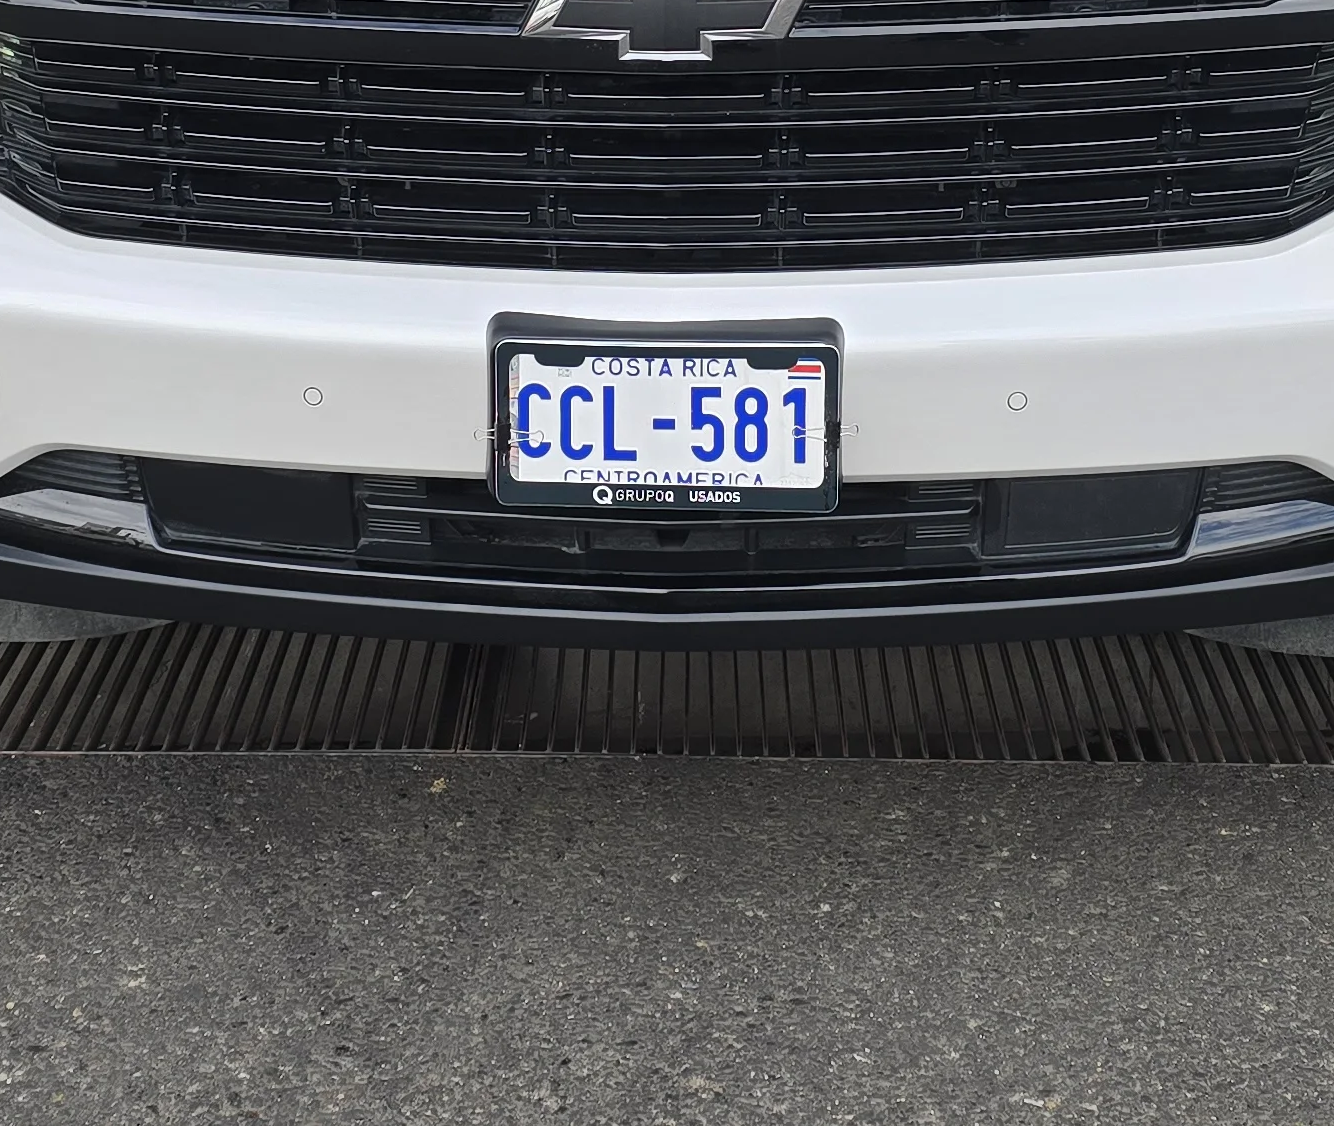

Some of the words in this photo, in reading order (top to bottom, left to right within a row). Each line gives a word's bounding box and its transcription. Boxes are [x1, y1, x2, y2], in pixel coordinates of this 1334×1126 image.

[591, 358, 673, 377] COSTA
[682, 358, 738, 378] RICA
[517, 382, 807, 464] CCL-581
[689, 490, 741, 503] USADOS
